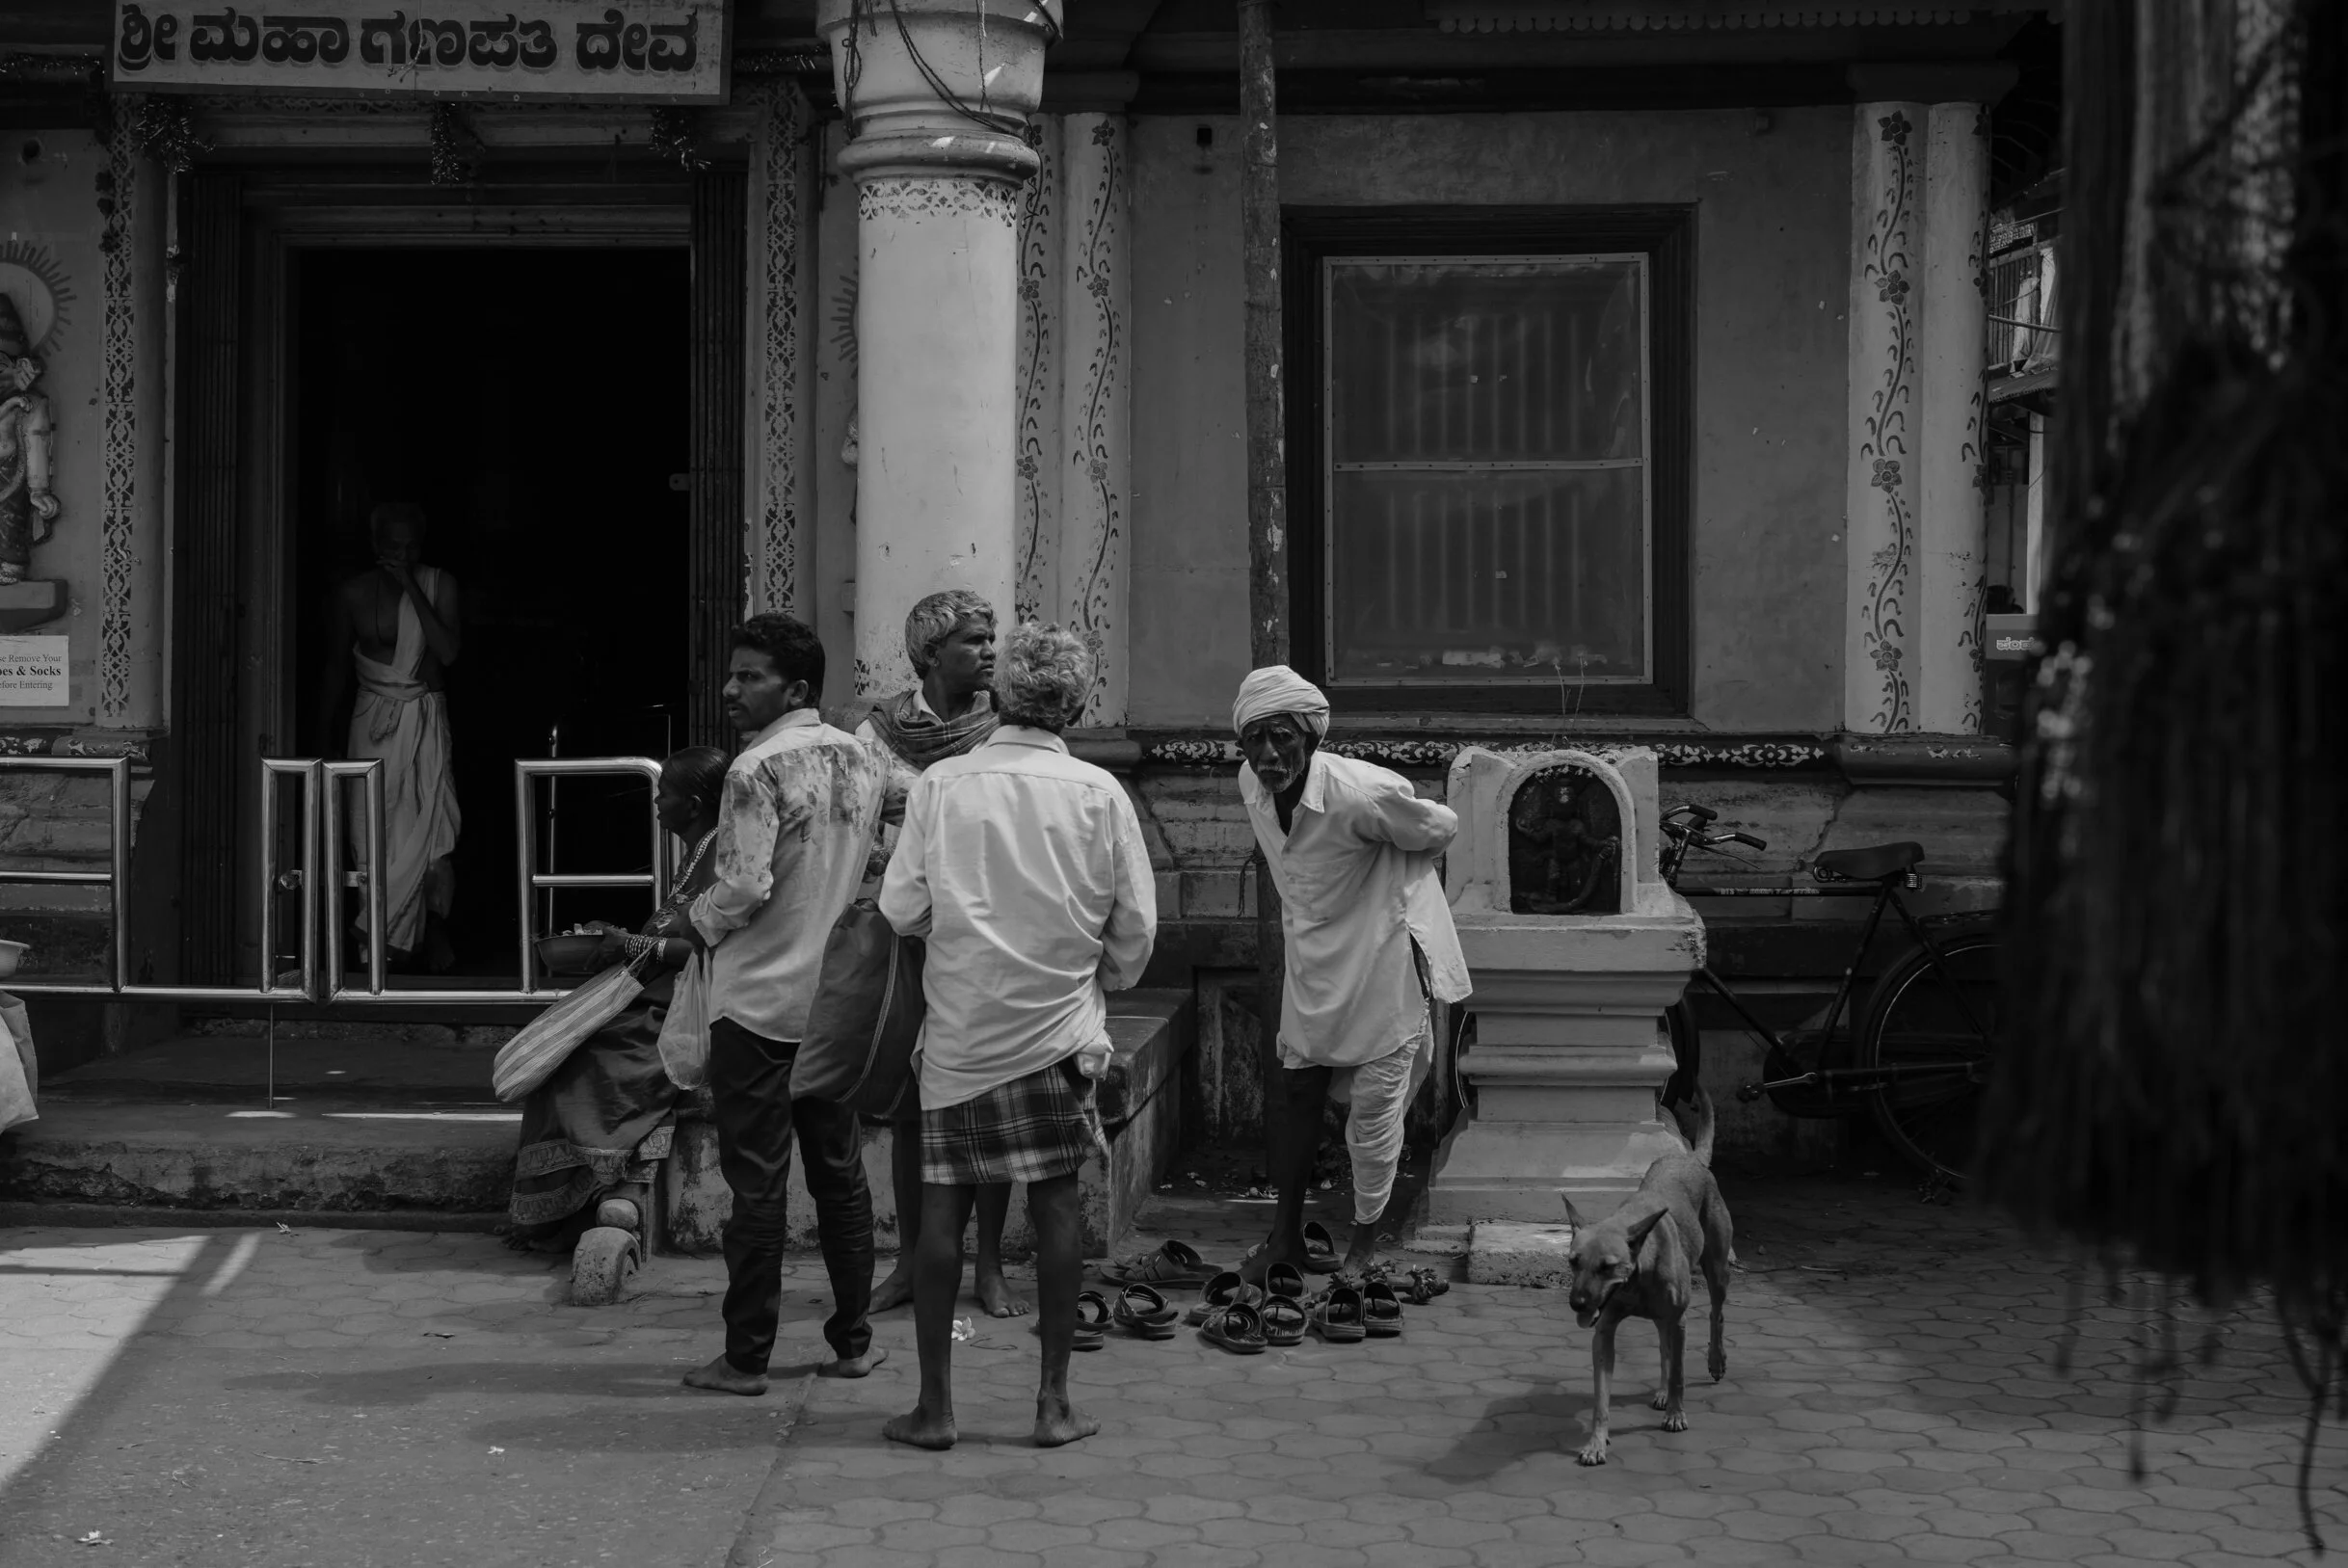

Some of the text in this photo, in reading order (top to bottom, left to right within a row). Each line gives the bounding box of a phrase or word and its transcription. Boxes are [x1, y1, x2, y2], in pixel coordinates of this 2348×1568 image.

[118, 3, 698, 71] ಶ್ರೀ ಮಹಾ ಗಣಪತಿ ದೇವ
[9, 654, 40, 663] Remove
[42, 653, 62, 662] Your
[16, 665, 26, 676] &
[30, 665, 62, 676] Socks
[19, 680, 53, 691] Entering
